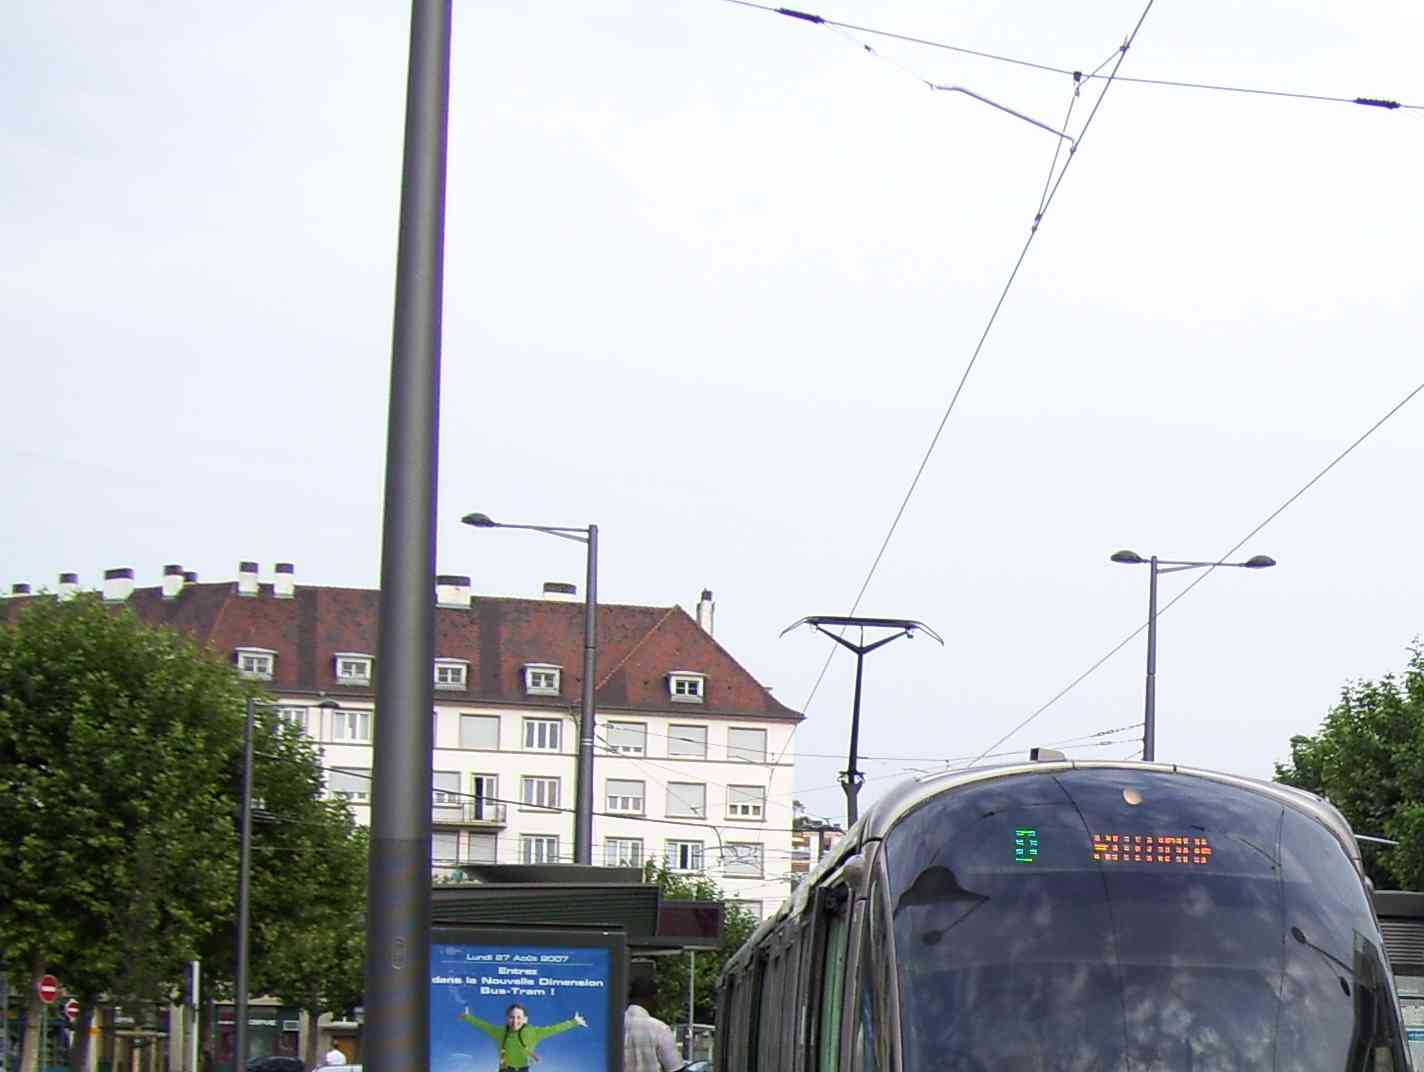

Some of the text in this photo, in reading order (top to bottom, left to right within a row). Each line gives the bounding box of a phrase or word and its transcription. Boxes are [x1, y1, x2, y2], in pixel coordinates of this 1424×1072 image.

[431, 976, 603, 987] dans la Nouvelle Dimension
[480, 986, 545, 995] Bus-Tram
